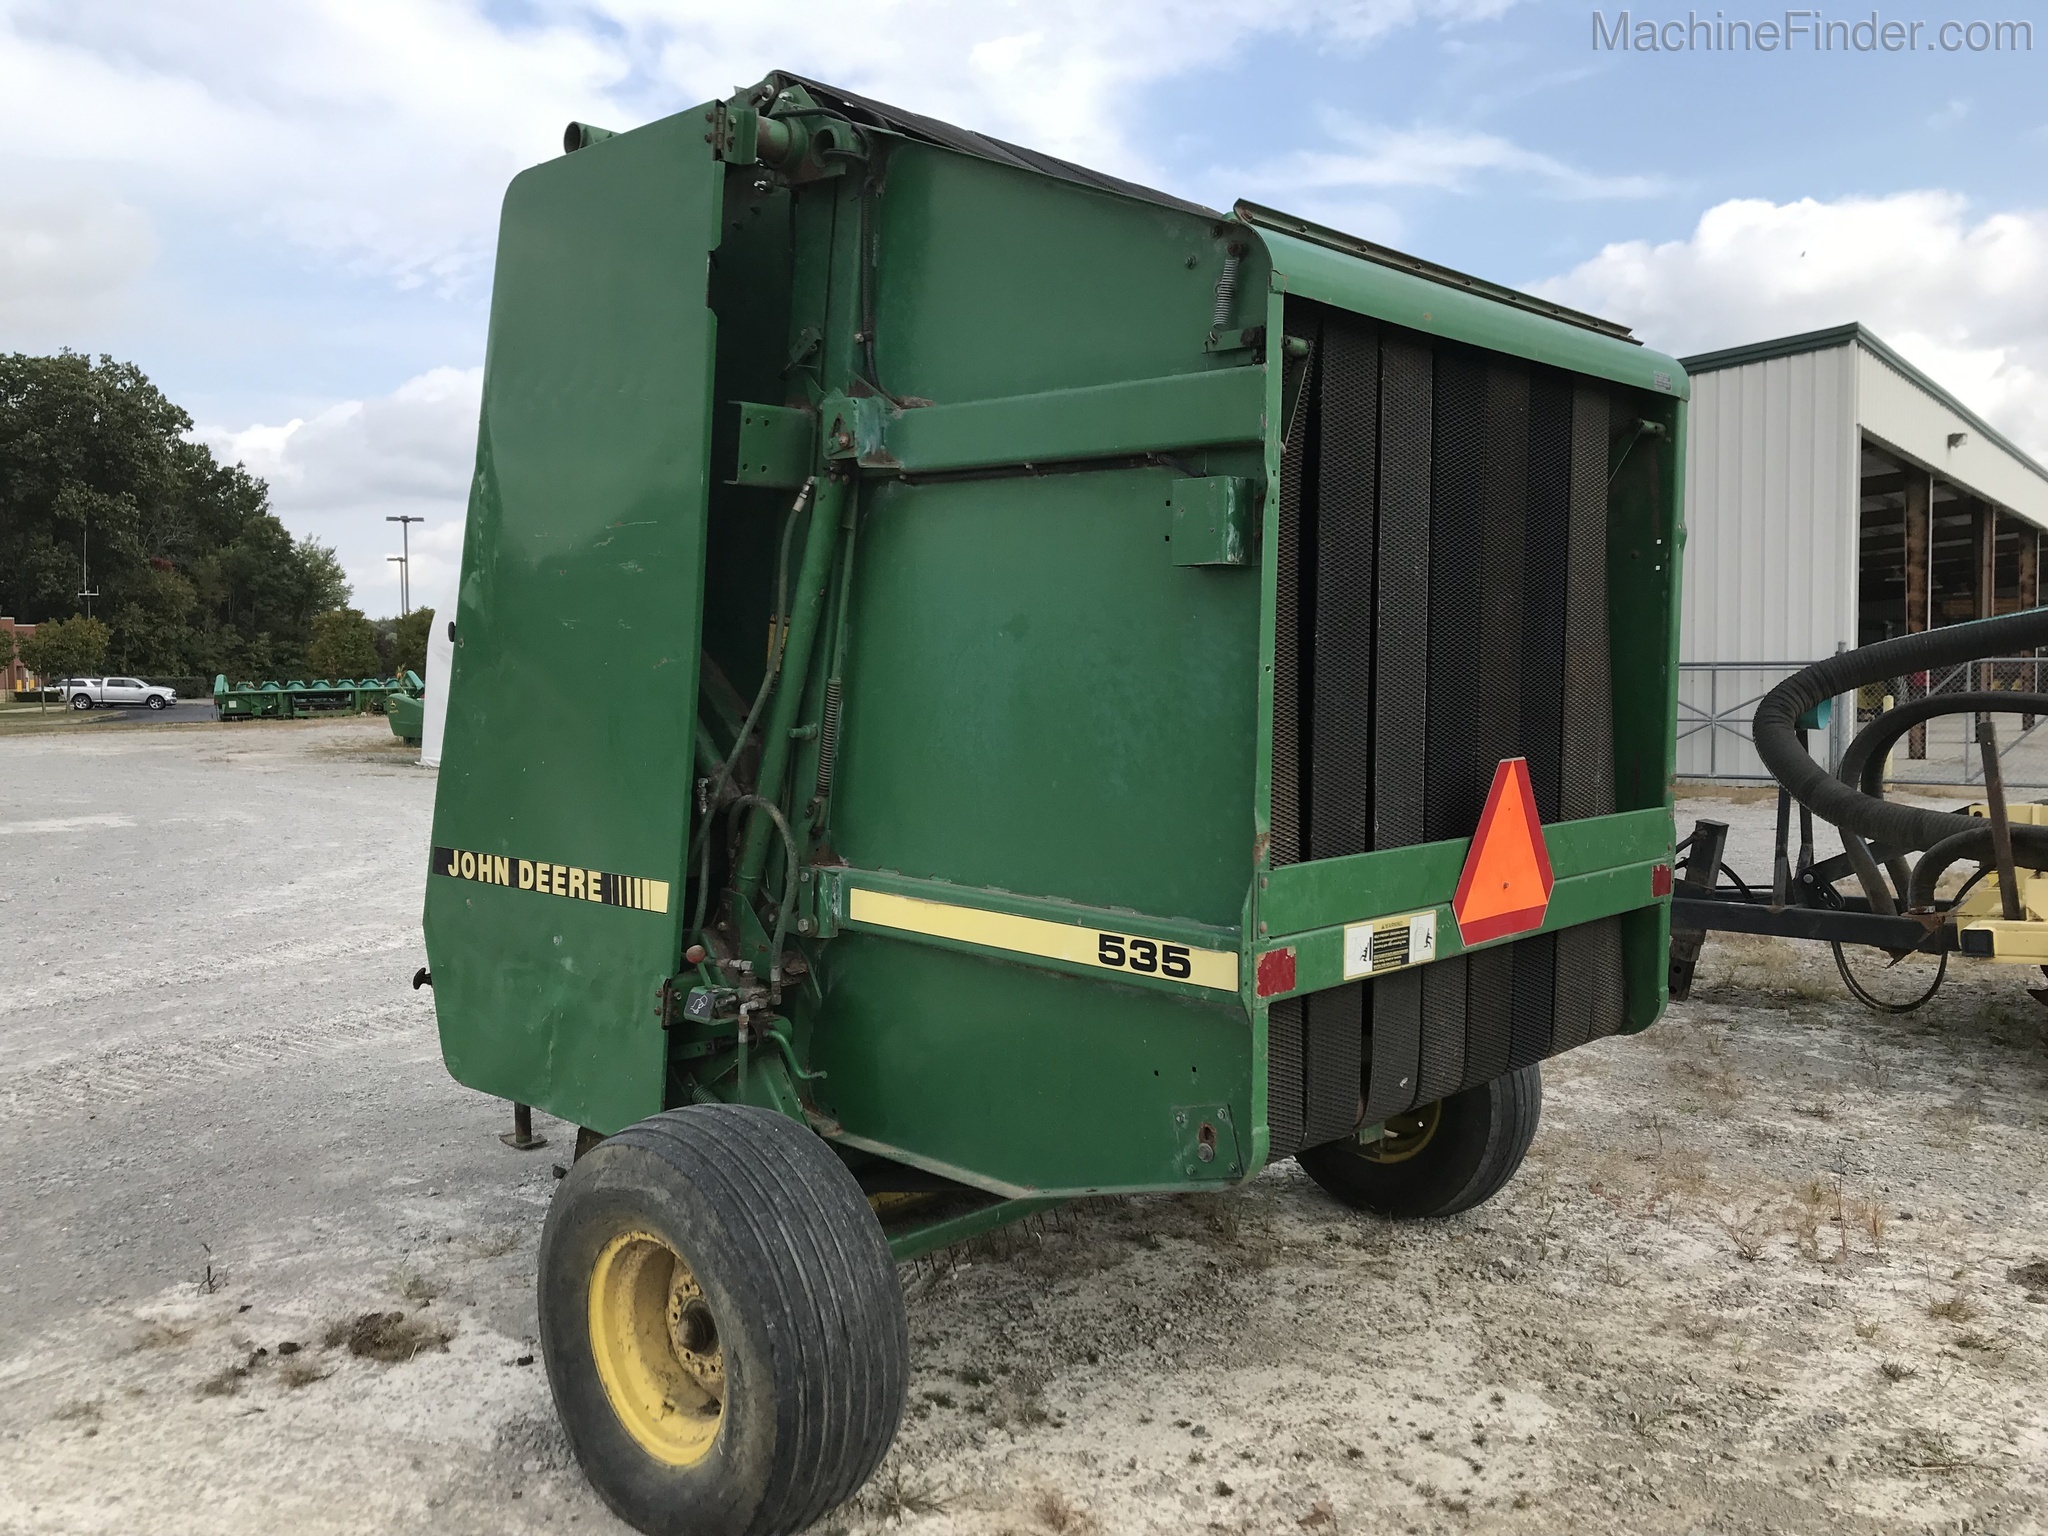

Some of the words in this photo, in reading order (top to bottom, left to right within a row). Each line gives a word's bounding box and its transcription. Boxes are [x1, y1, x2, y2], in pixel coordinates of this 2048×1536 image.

[447, 849, 510, 887] JOHN
[518, 859, 603, 903] DEERE
[1098, 933, 1191, 979] 535
